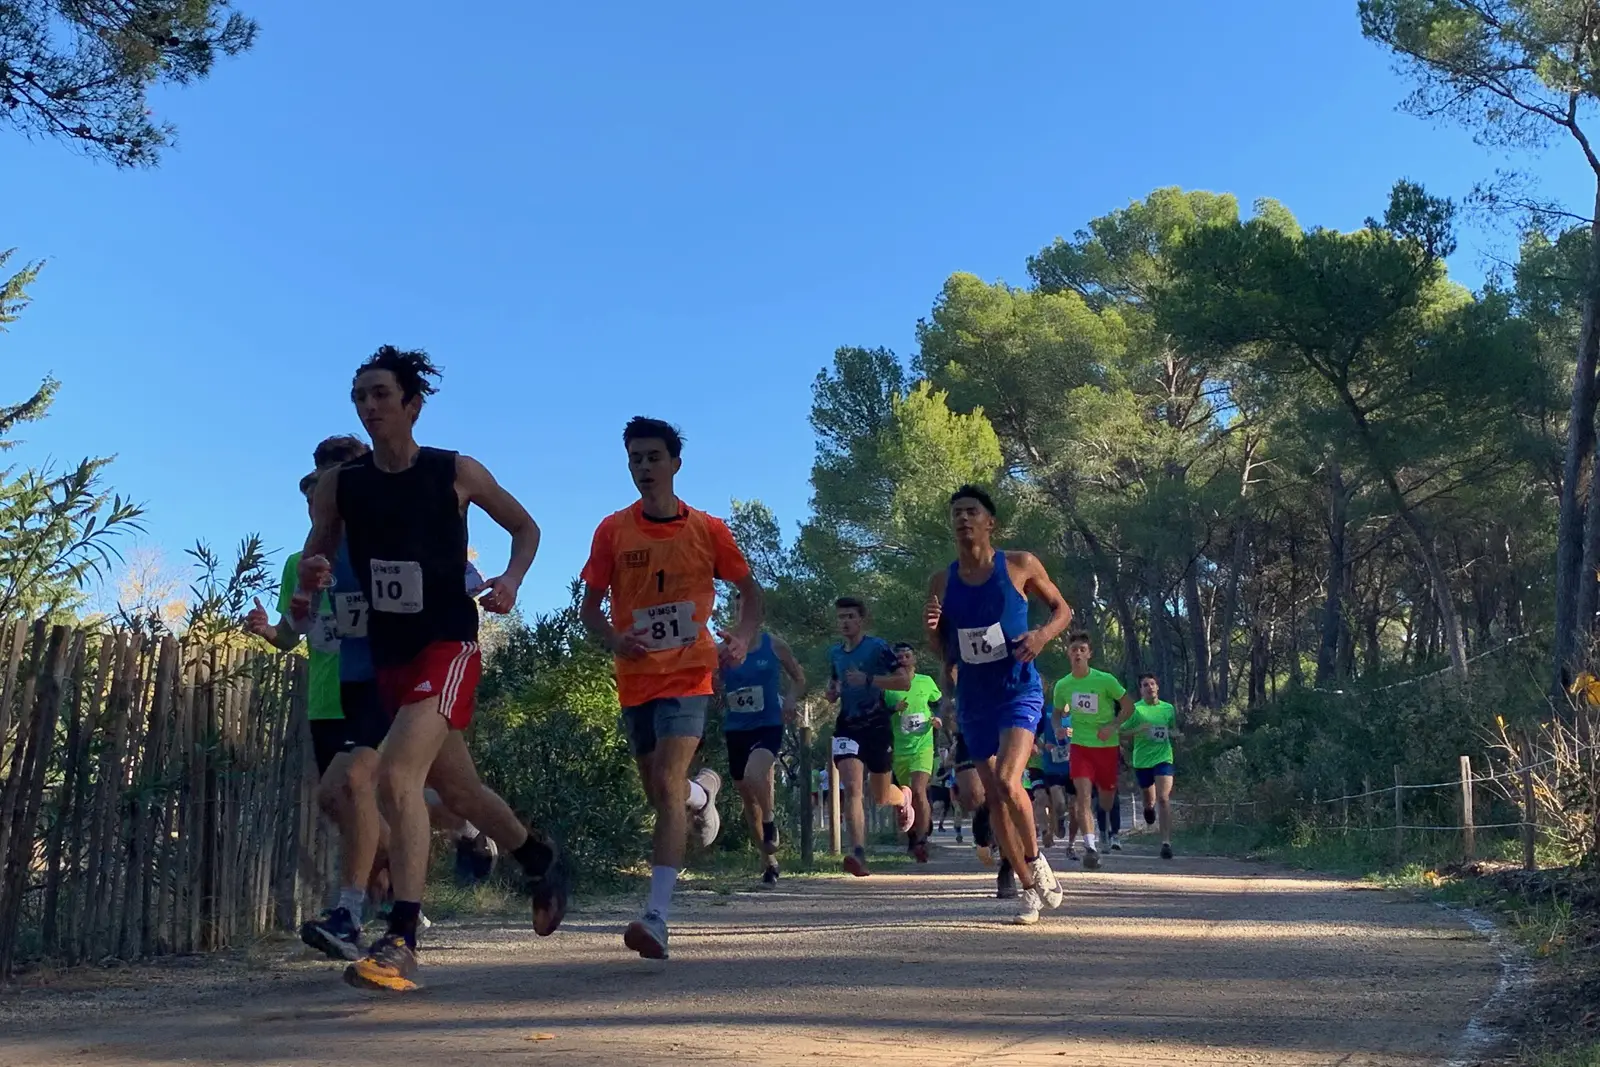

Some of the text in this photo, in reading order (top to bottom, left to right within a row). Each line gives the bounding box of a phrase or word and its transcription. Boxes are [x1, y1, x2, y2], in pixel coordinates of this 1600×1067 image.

[375, 579, 403, 601] 10
[656, 568, 665, 593] 1
[348, 608, 369, 627] 7
[651, 619, 680, 640] 81
[971, 640, 992, 656] 16
[737, 695, 754, 706] 64
[1077, 700, 1091, 709] 40
